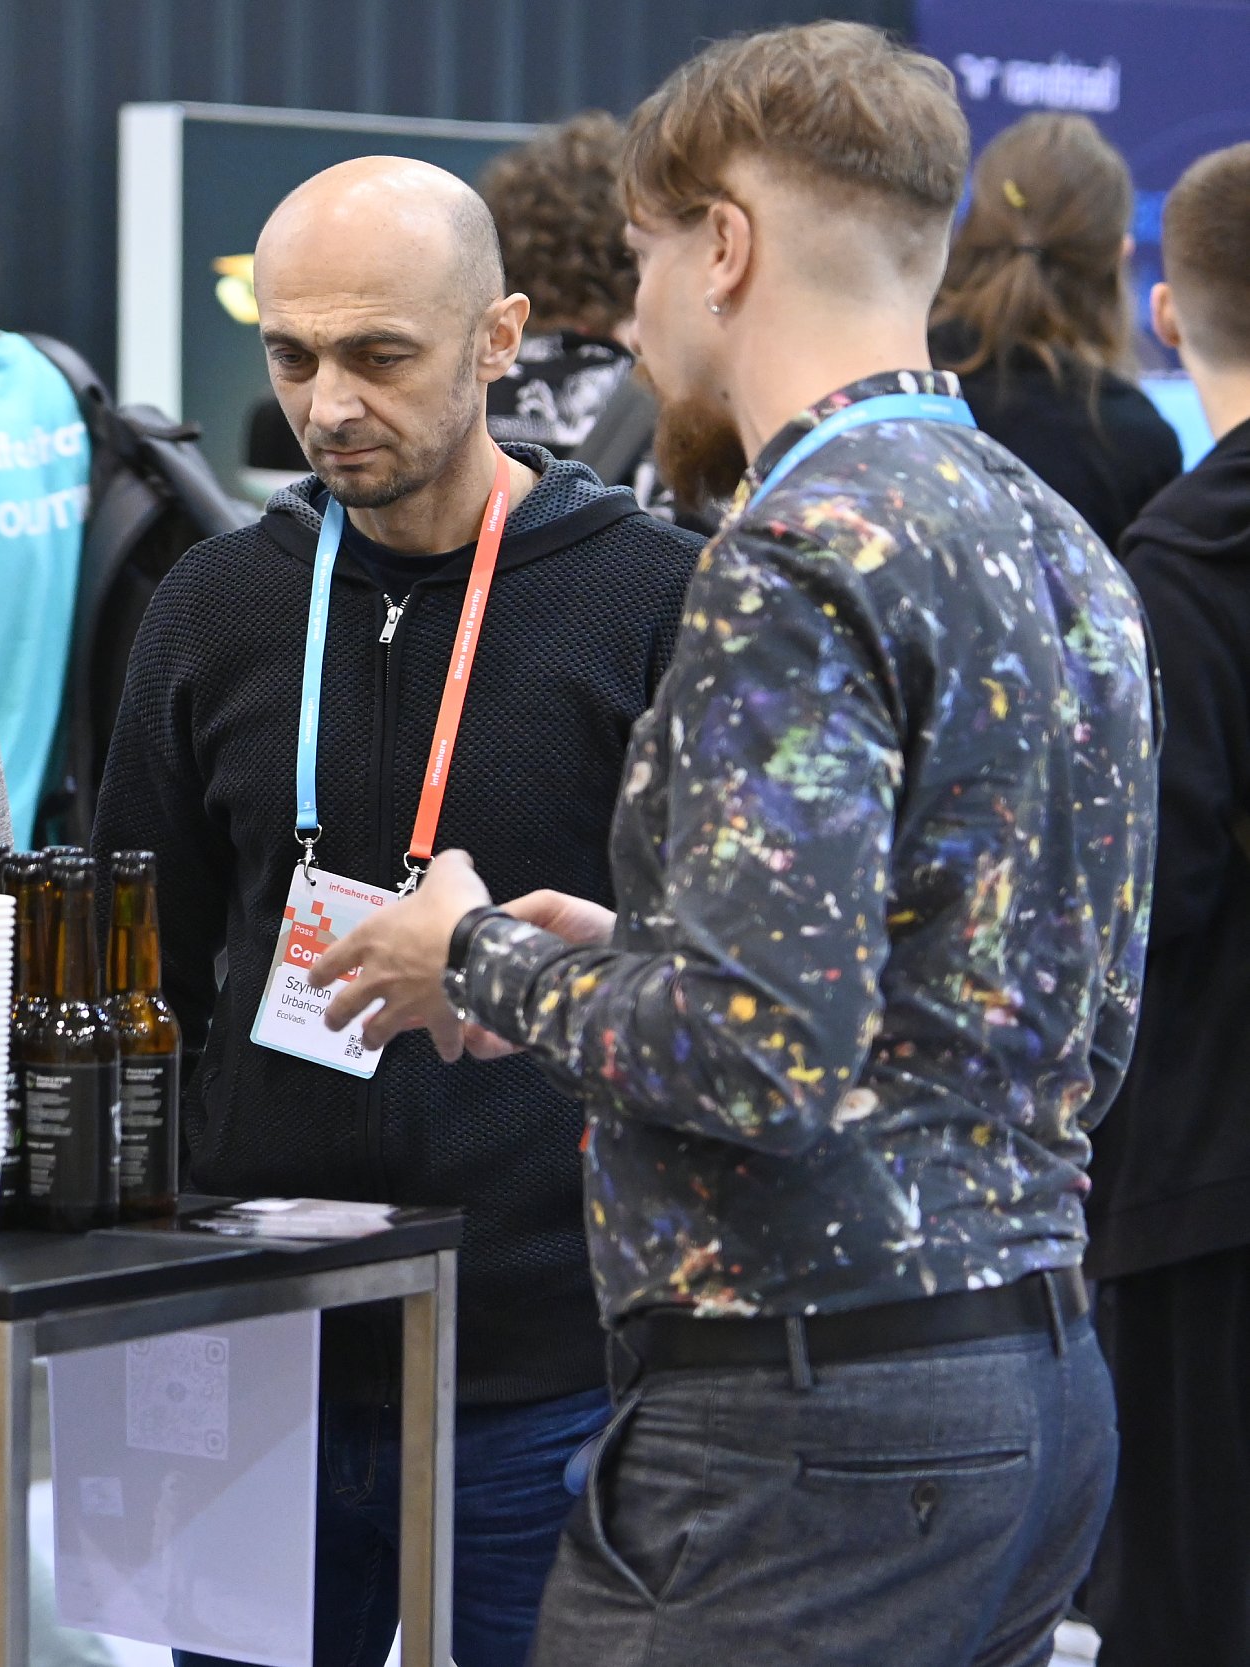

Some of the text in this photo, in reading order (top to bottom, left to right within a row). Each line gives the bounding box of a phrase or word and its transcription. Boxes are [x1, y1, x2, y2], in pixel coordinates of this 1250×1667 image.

[487, 491, 504, 532] infoshare
[454, 655, 466, 680] Share
[461, 630, 472, 653] what
[467, 588, 483, 619] worthy
[304, 697, 315, 744] infoshare
[430, 739, 447, 787] infoshare
[329, 882, 369, 901] infoshare
[294, 924, 314, 937] Pass
[285, 975, 332, 1001] Szymon
[276, 1009, 307, 1025] EcoVadis
[281, 993, 327, 1017] Urbańczy
